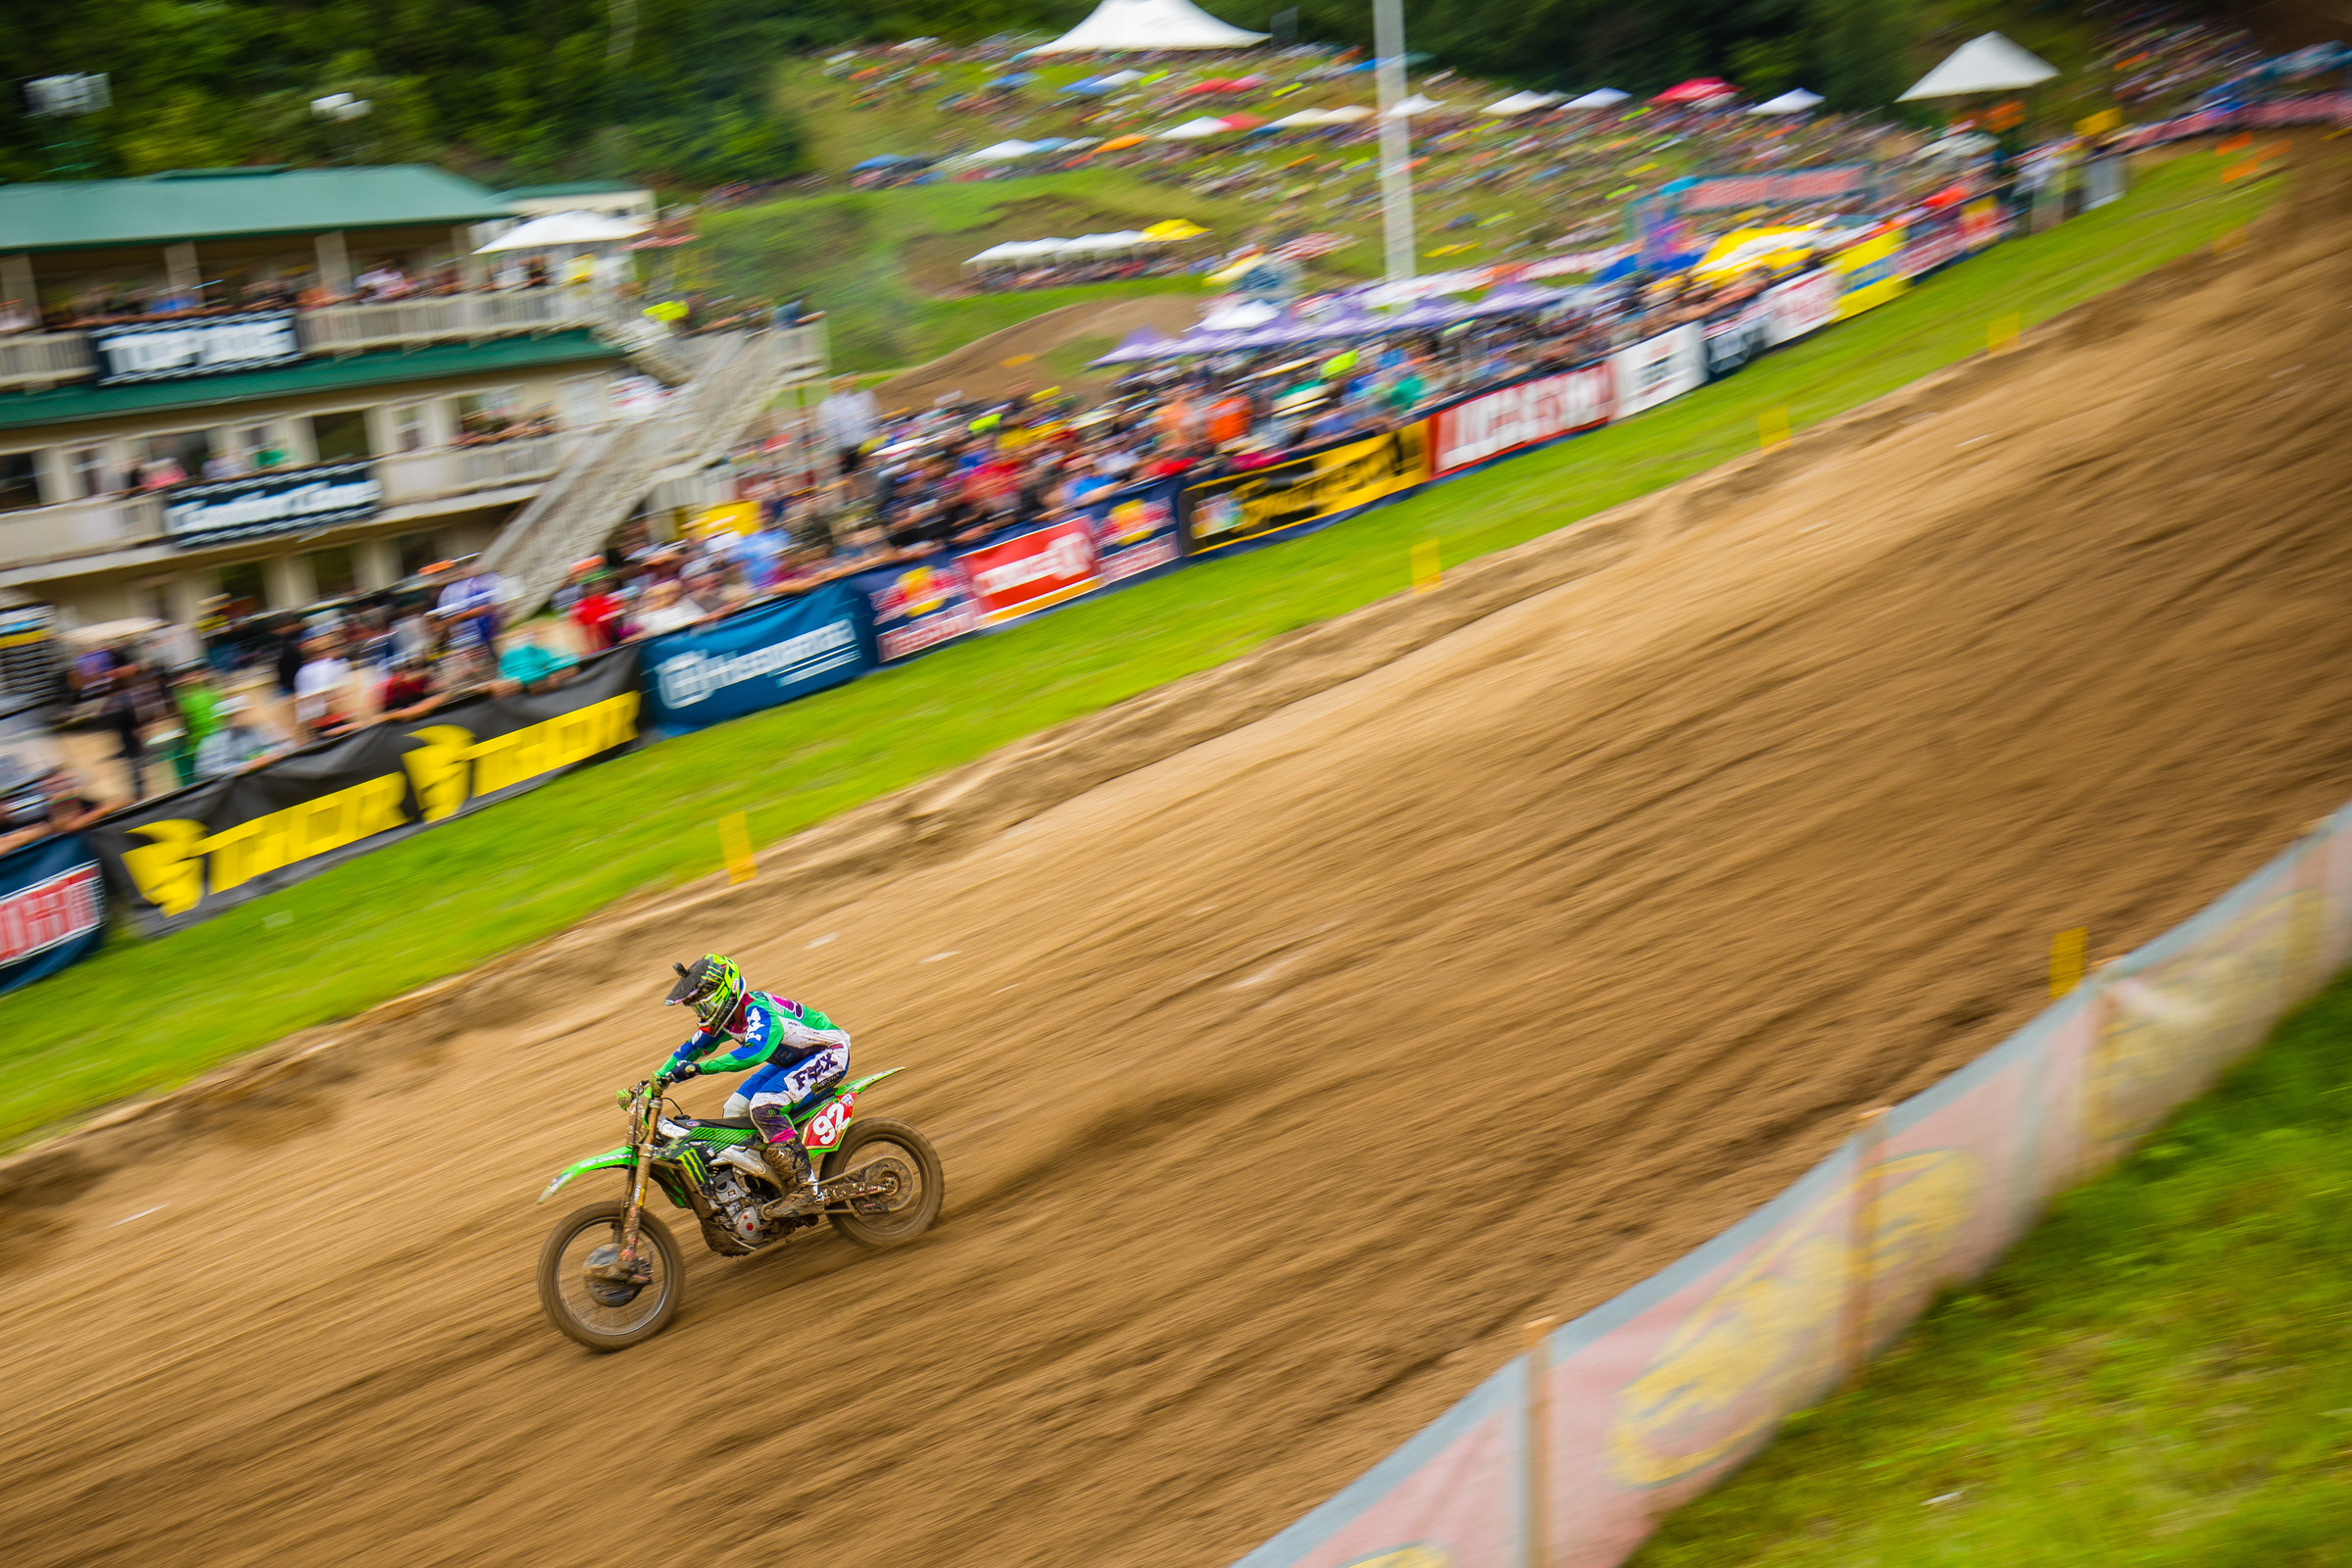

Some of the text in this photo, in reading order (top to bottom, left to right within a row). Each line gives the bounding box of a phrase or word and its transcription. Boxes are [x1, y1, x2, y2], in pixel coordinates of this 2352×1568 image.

[465, 690, 640, 799] THOR
[194, 771, 415, 896] THOR
[812, 1102, 851, 1145] 92
